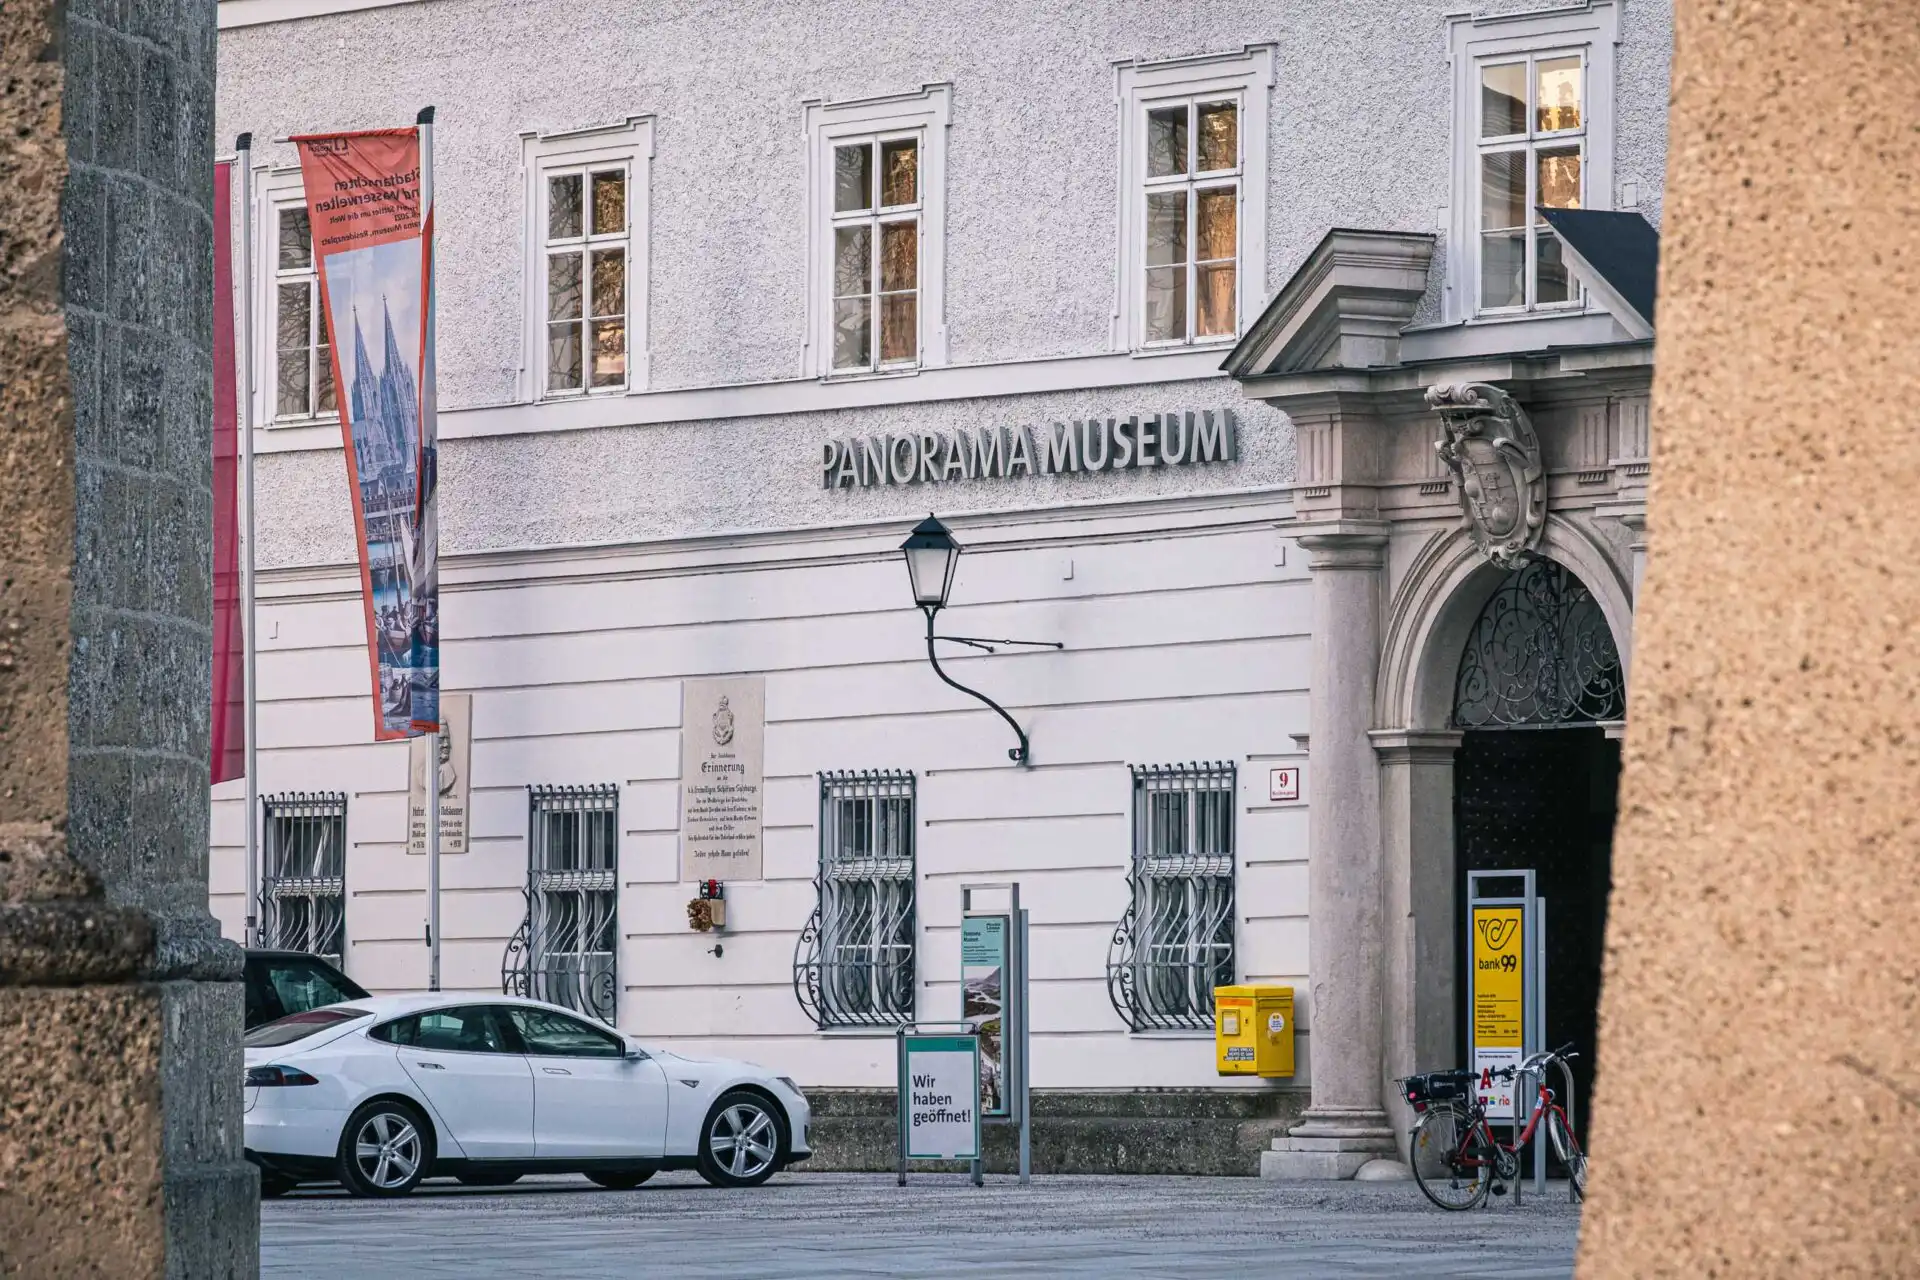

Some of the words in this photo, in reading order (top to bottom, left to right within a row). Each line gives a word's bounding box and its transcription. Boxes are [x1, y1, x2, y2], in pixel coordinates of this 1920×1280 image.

[823, 424, 1038, 490] PANORAMA
[1040, 408, 1237, 474] MUSEUM
[701, 761, 745, 774] Erinnerung
[1279, 772, 1288, 788] 9
[913, 1074, 936, 1088] Wir
[913, 1092, 952, 1105] haben
[913, 1108, 971, 1127] geöffnet!
